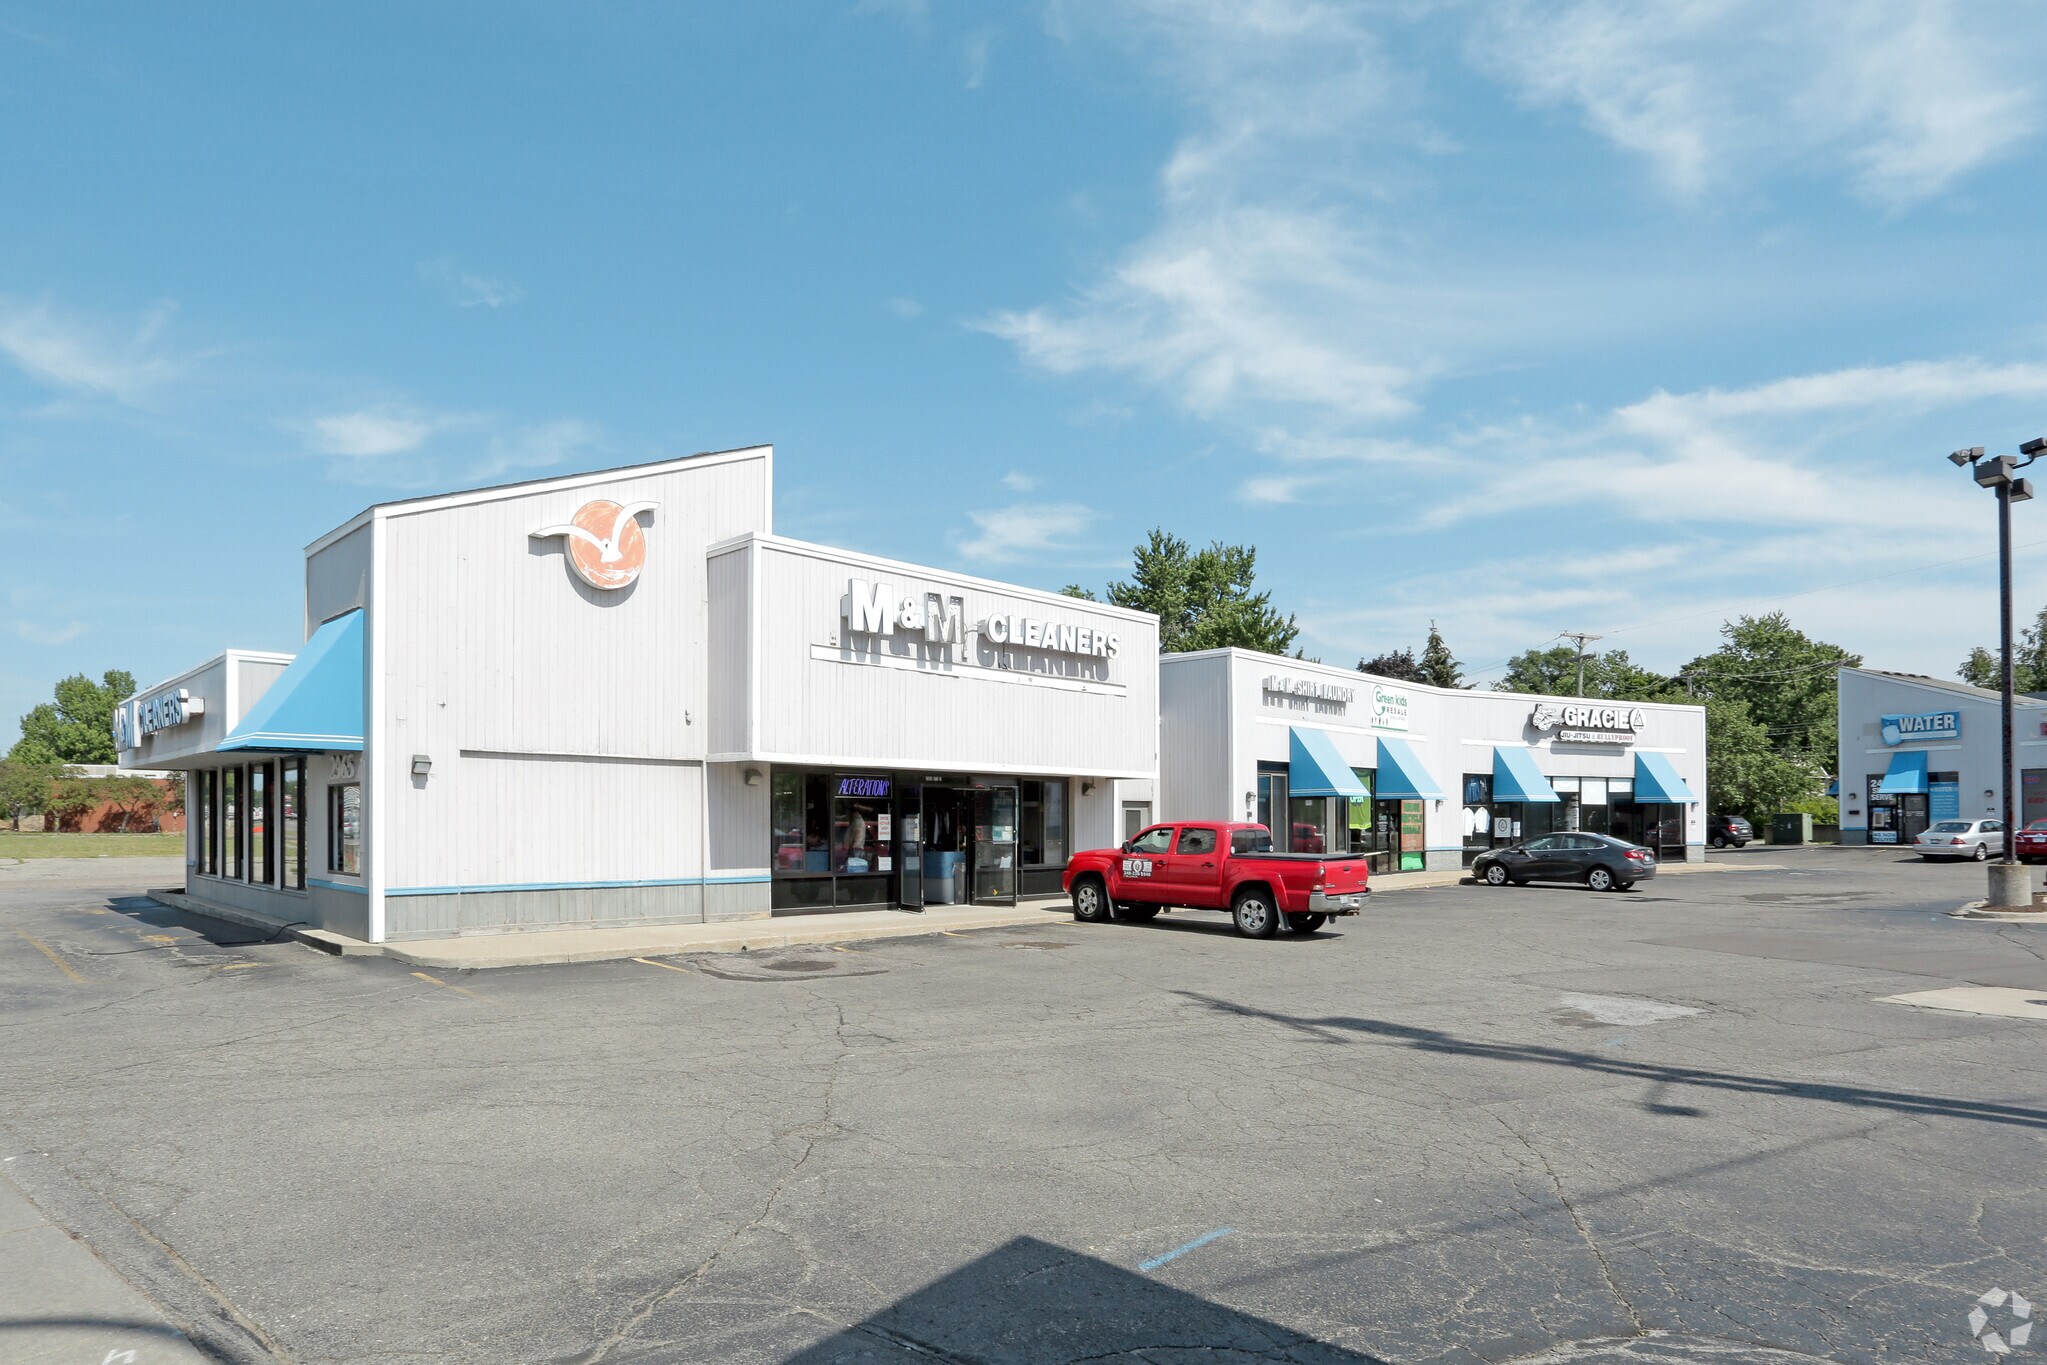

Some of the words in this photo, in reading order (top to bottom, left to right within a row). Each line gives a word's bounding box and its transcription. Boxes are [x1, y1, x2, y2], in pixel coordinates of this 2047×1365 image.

[987, 613, 1121, 658] CLEANERS
[1297, 680, 1320, 699] SHIRT
[1322, 684, 1356, 703] LAUNDRY
[1375, 691, 1394, 704] Green
[1395, 696, 1408, 707] kids
[138, 688, 183, 736] CLEANERS
[1386, 706, 1408, 716] RESALE
[1564, 706, 1630, 729] GRACIE
[1899, 714, 1955, 731] WATER
[1561, 731, 1591, 740] JIU-JITSU
[839, 778, 890, 796] ALTERATIONS
[1871, 793, 1894, 801] SERVE
